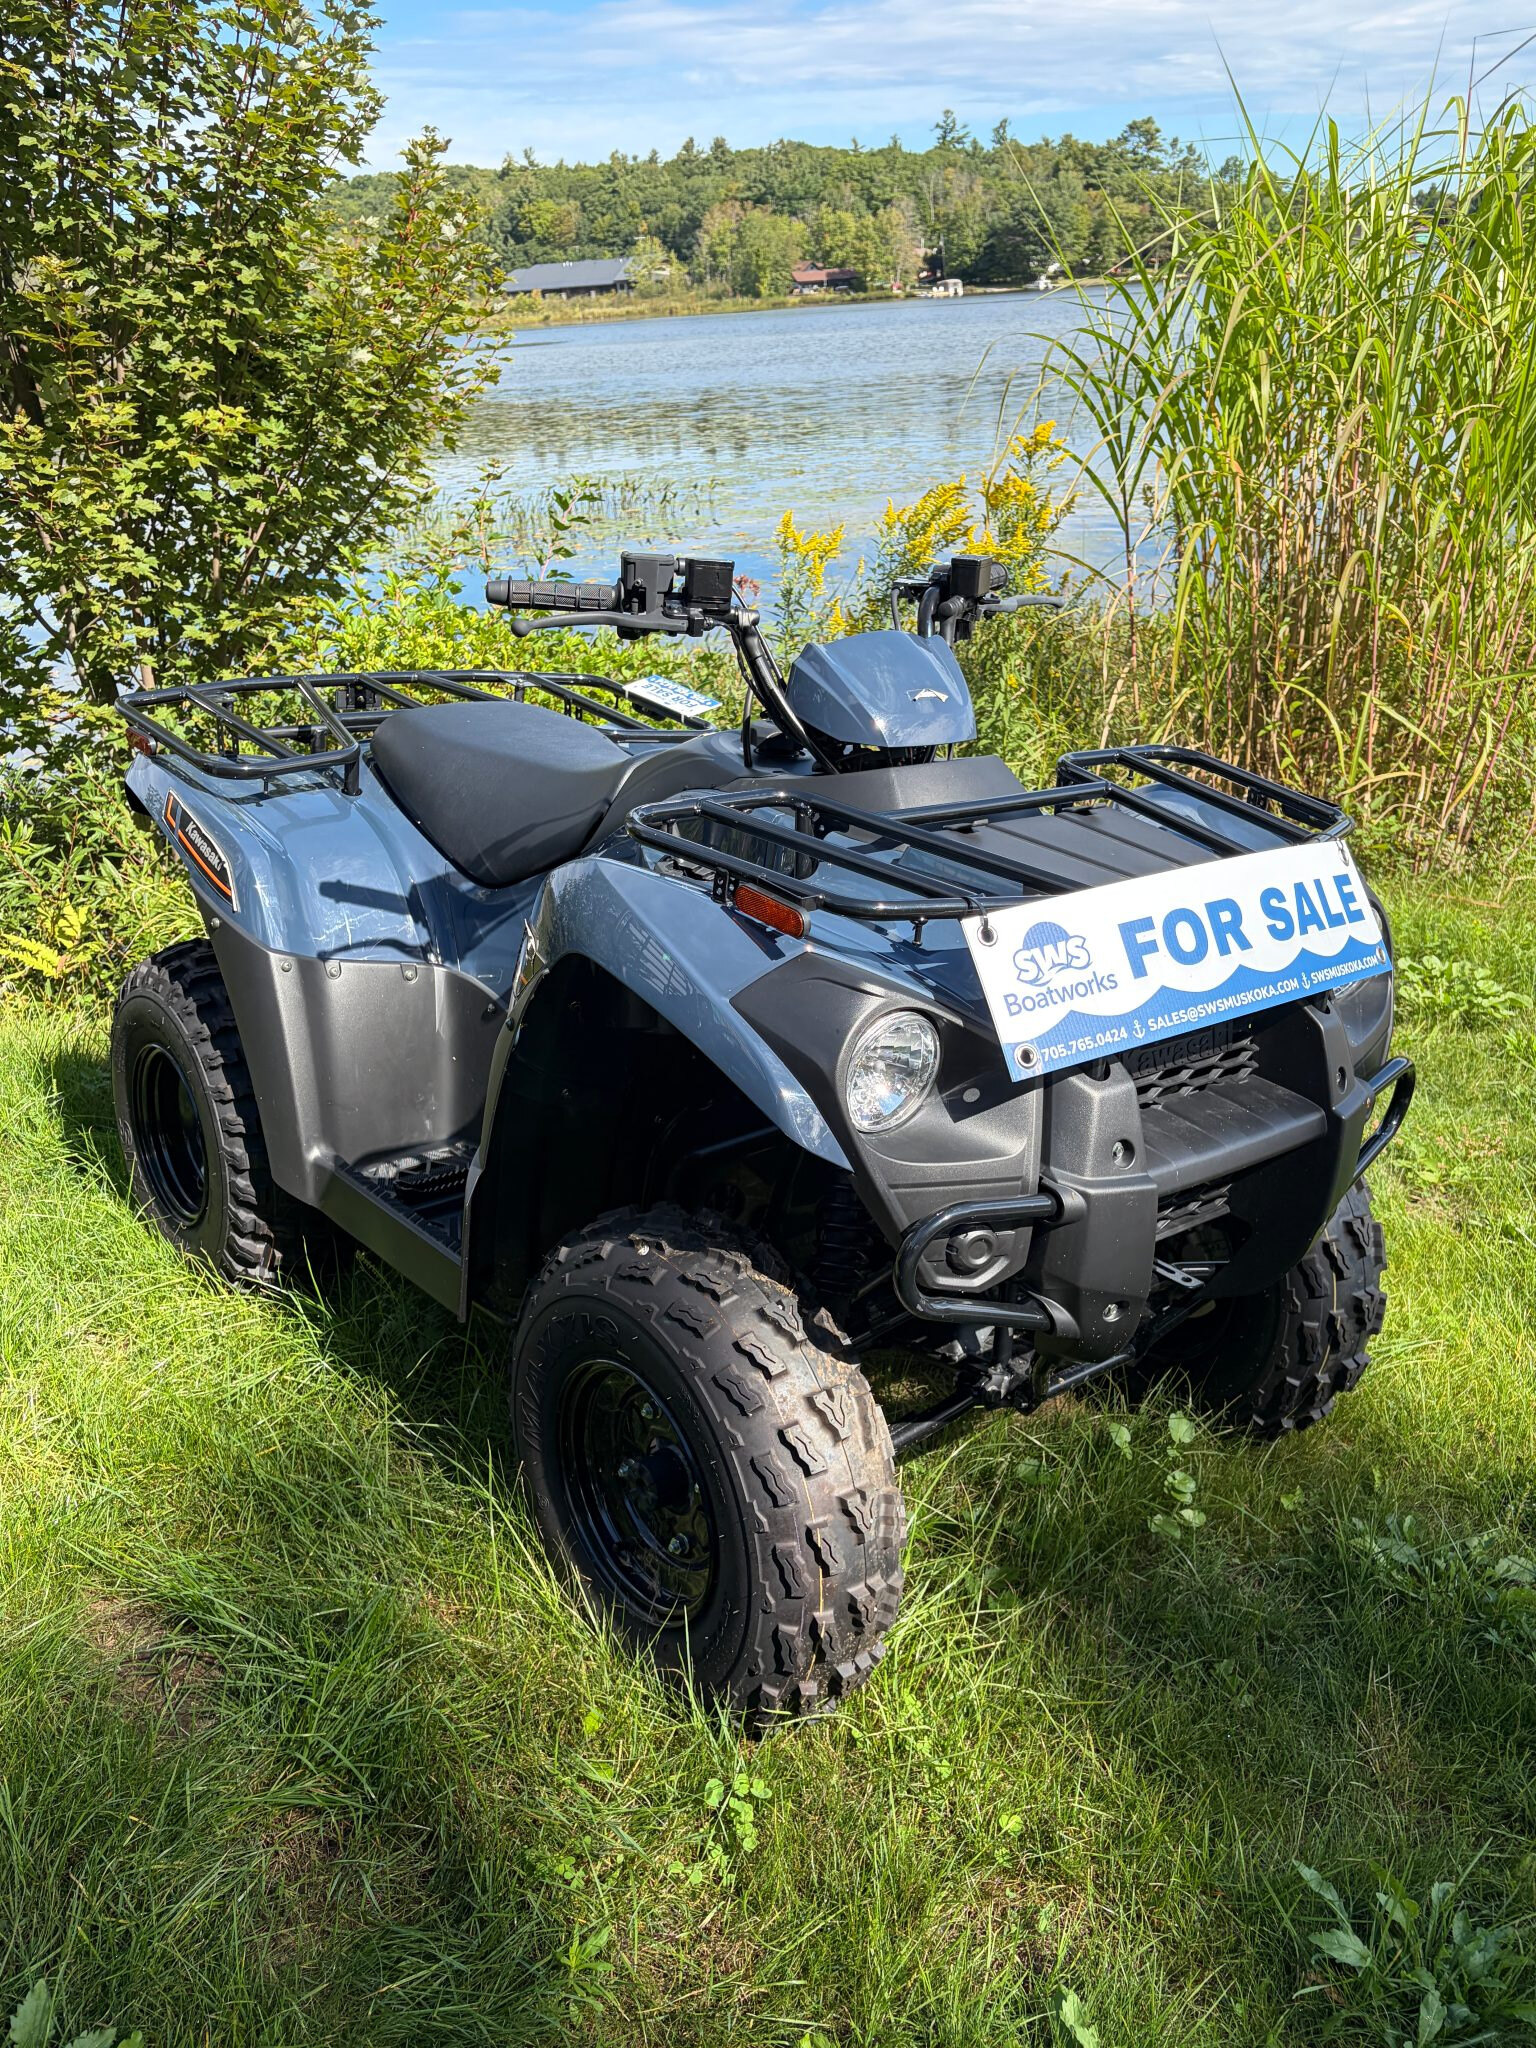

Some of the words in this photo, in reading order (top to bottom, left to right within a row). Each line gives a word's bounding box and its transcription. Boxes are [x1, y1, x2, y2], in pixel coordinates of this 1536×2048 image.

[641, 684, 672, 697] SALE
[672, 696, 698, 708] FOR
[185, 820, 223, 871] Kawasaki
[1117, 897, 1253, 980] FOR
[1259, 873, 1366, 942] SALE
[1013, 934, 1092, 986] SWS
[1002, 970, 1118, 1017] Boatworks
[1040, 1026, 1128, 1062] 705.765.0424
[1147, 977, 1300, 1031] SALES@SWSMUSKOKA.COM
[1310, 954, 1379, 984] SWSMUSKOKA.COM
